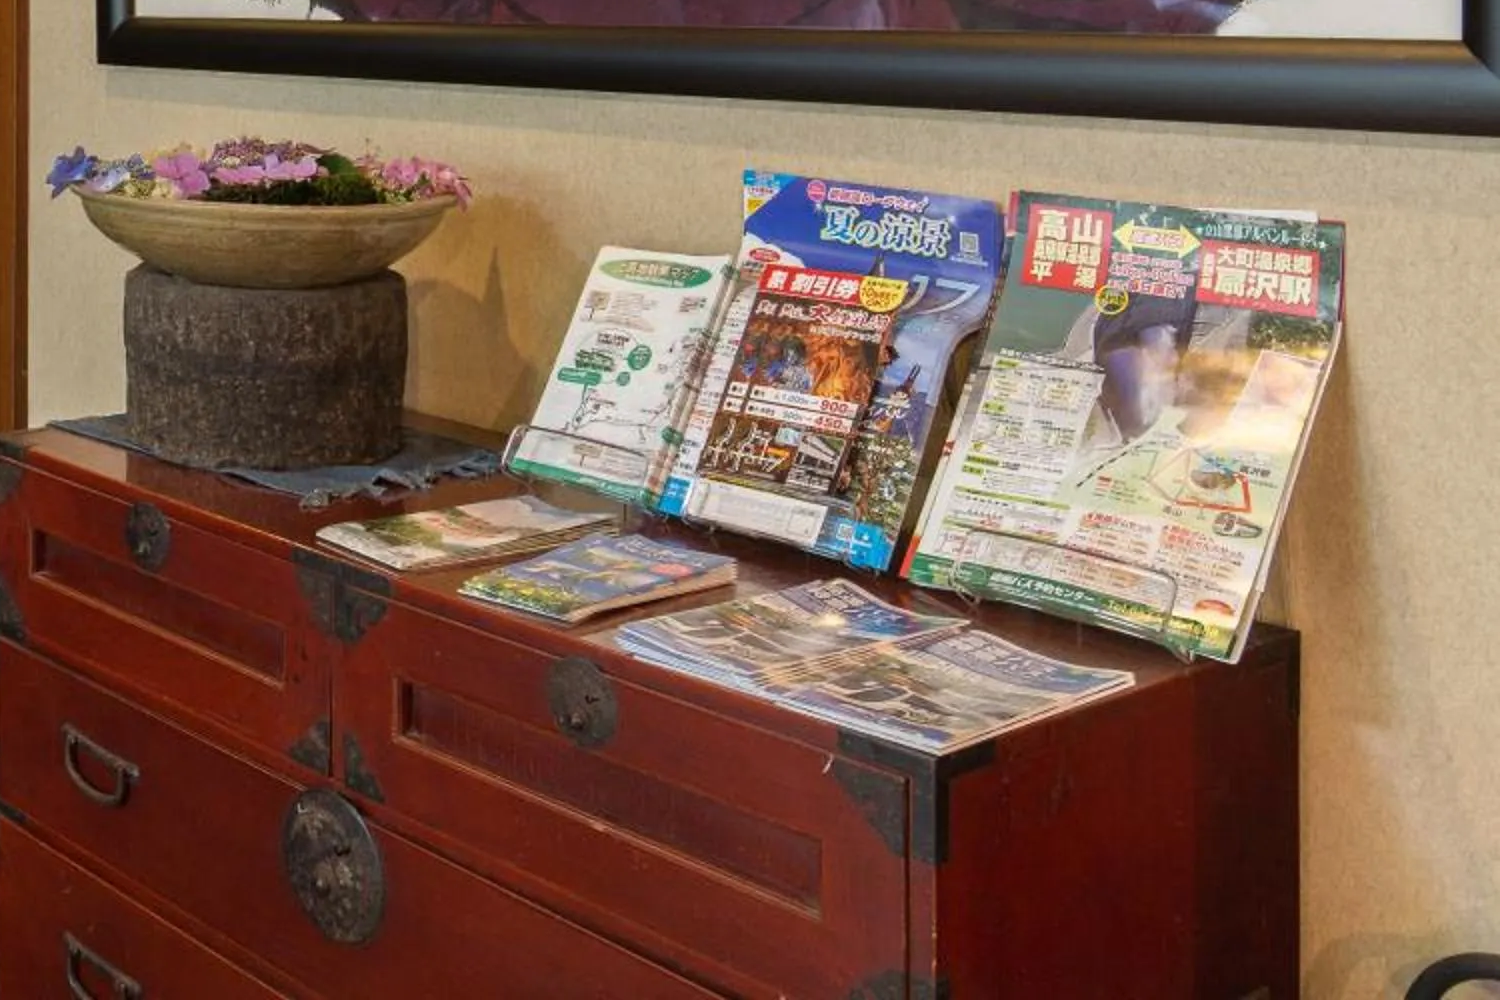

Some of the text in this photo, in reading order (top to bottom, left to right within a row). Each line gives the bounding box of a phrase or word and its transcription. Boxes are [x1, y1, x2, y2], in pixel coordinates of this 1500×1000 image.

[820, 203, 952, 258] 夏の涼景
[1037, 208, 1104, 245] 高山
[790, 275, 861, 302] 割引券
